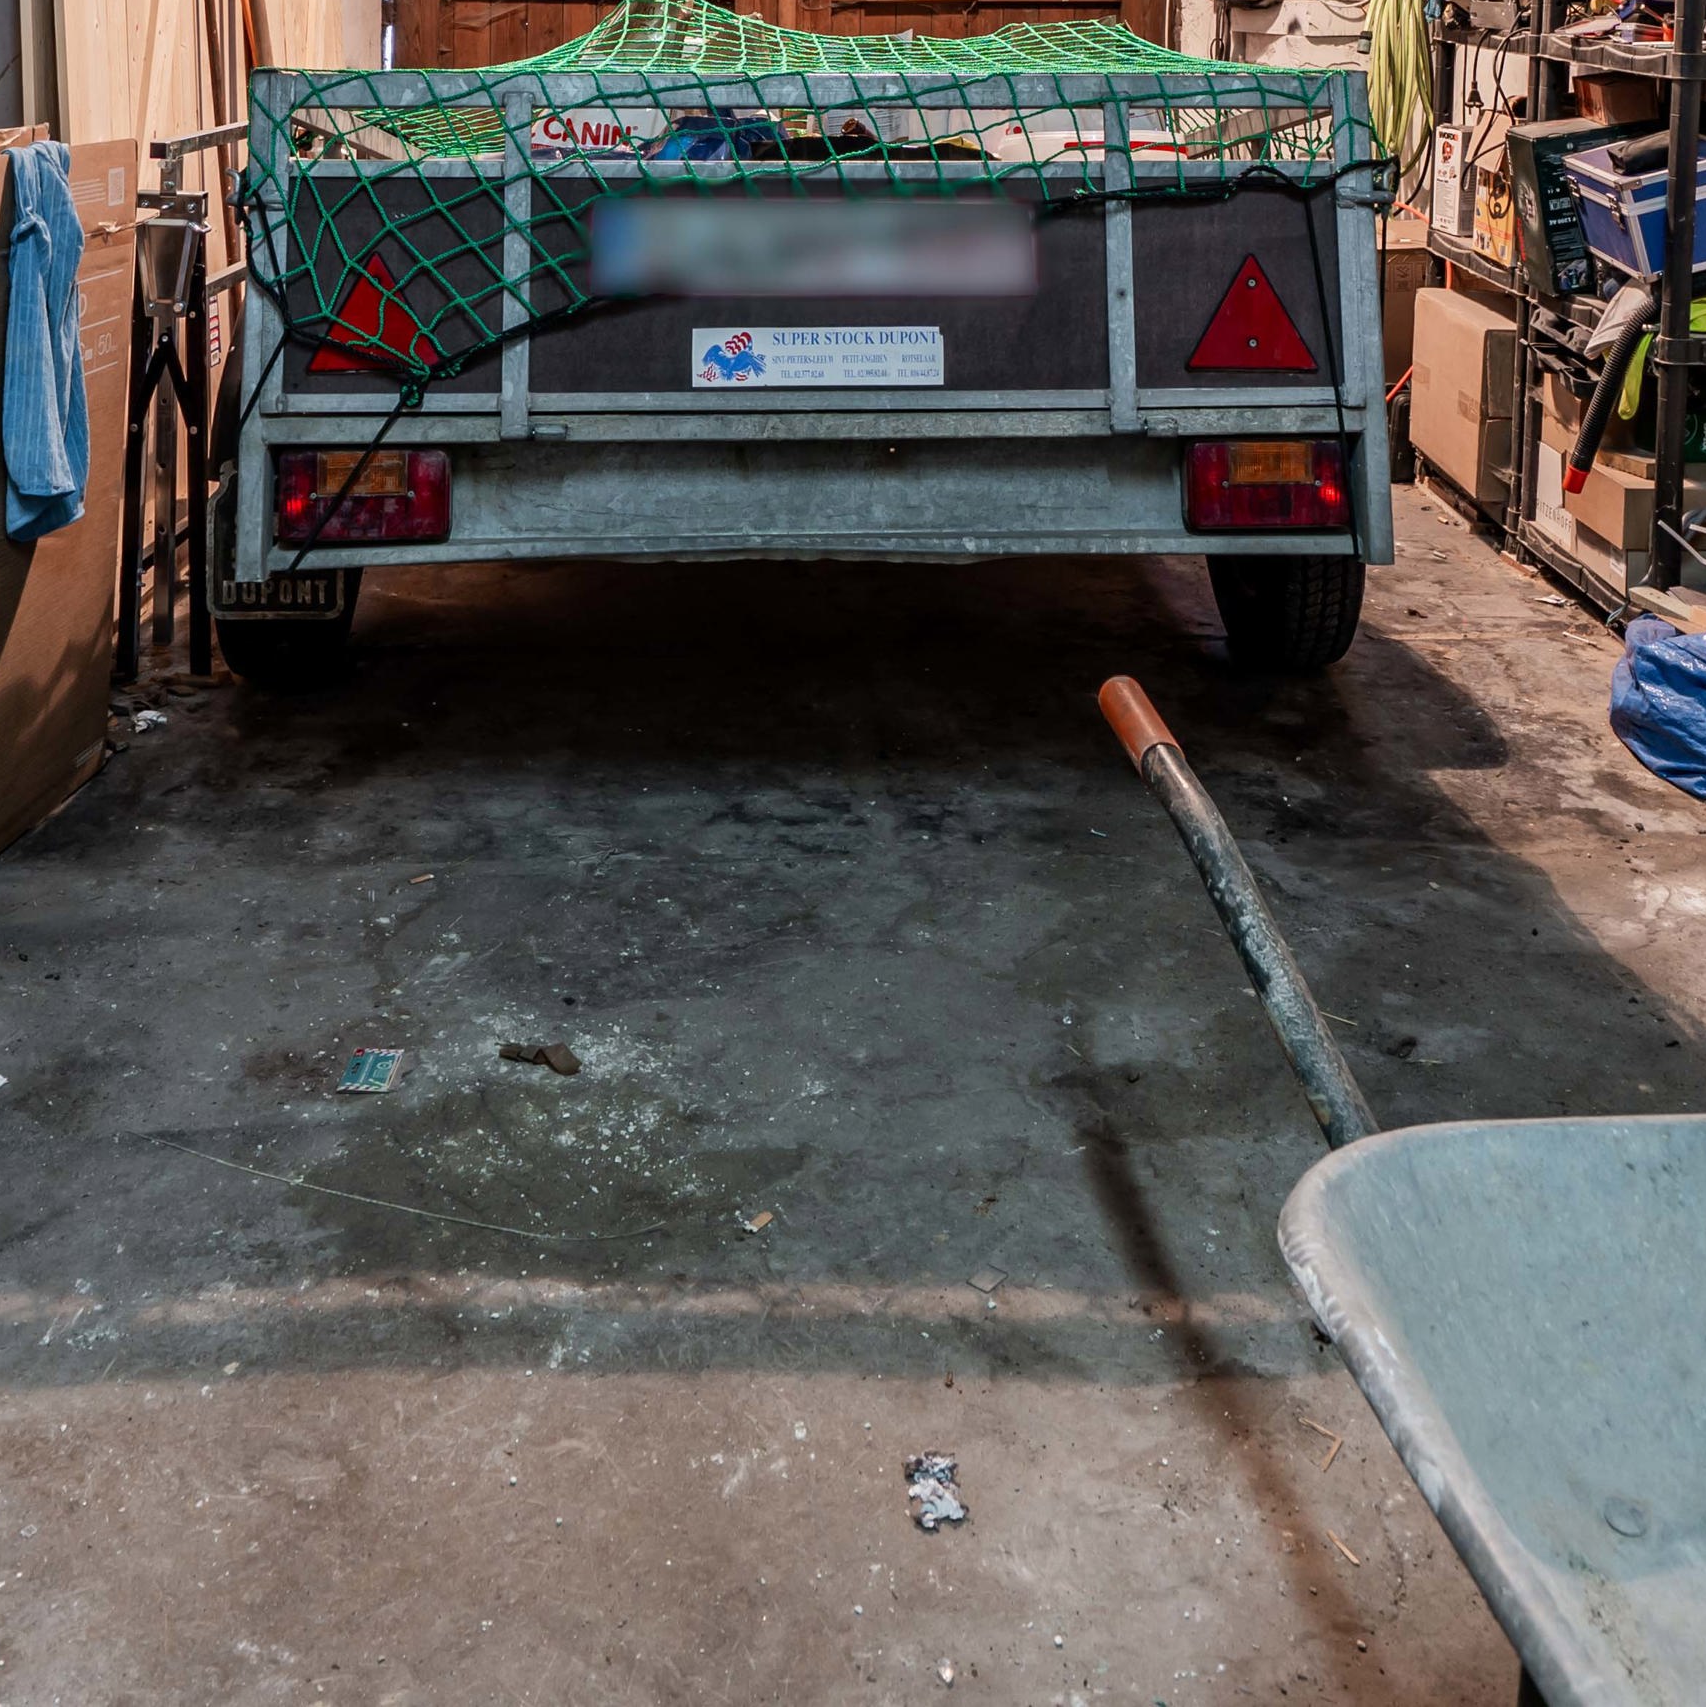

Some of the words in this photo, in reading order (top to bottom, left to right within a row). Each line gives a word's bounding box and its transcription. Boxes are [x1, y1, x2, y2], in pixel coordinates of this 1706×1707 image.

[543, 116, 631, 146] CANIN
[772, 331, 819, 346] SUPER
[823, 331, 873, 346] STOCK
[879, 330, 938, 345] DUPONT
[222, 579, 329, 606] DUPONT
